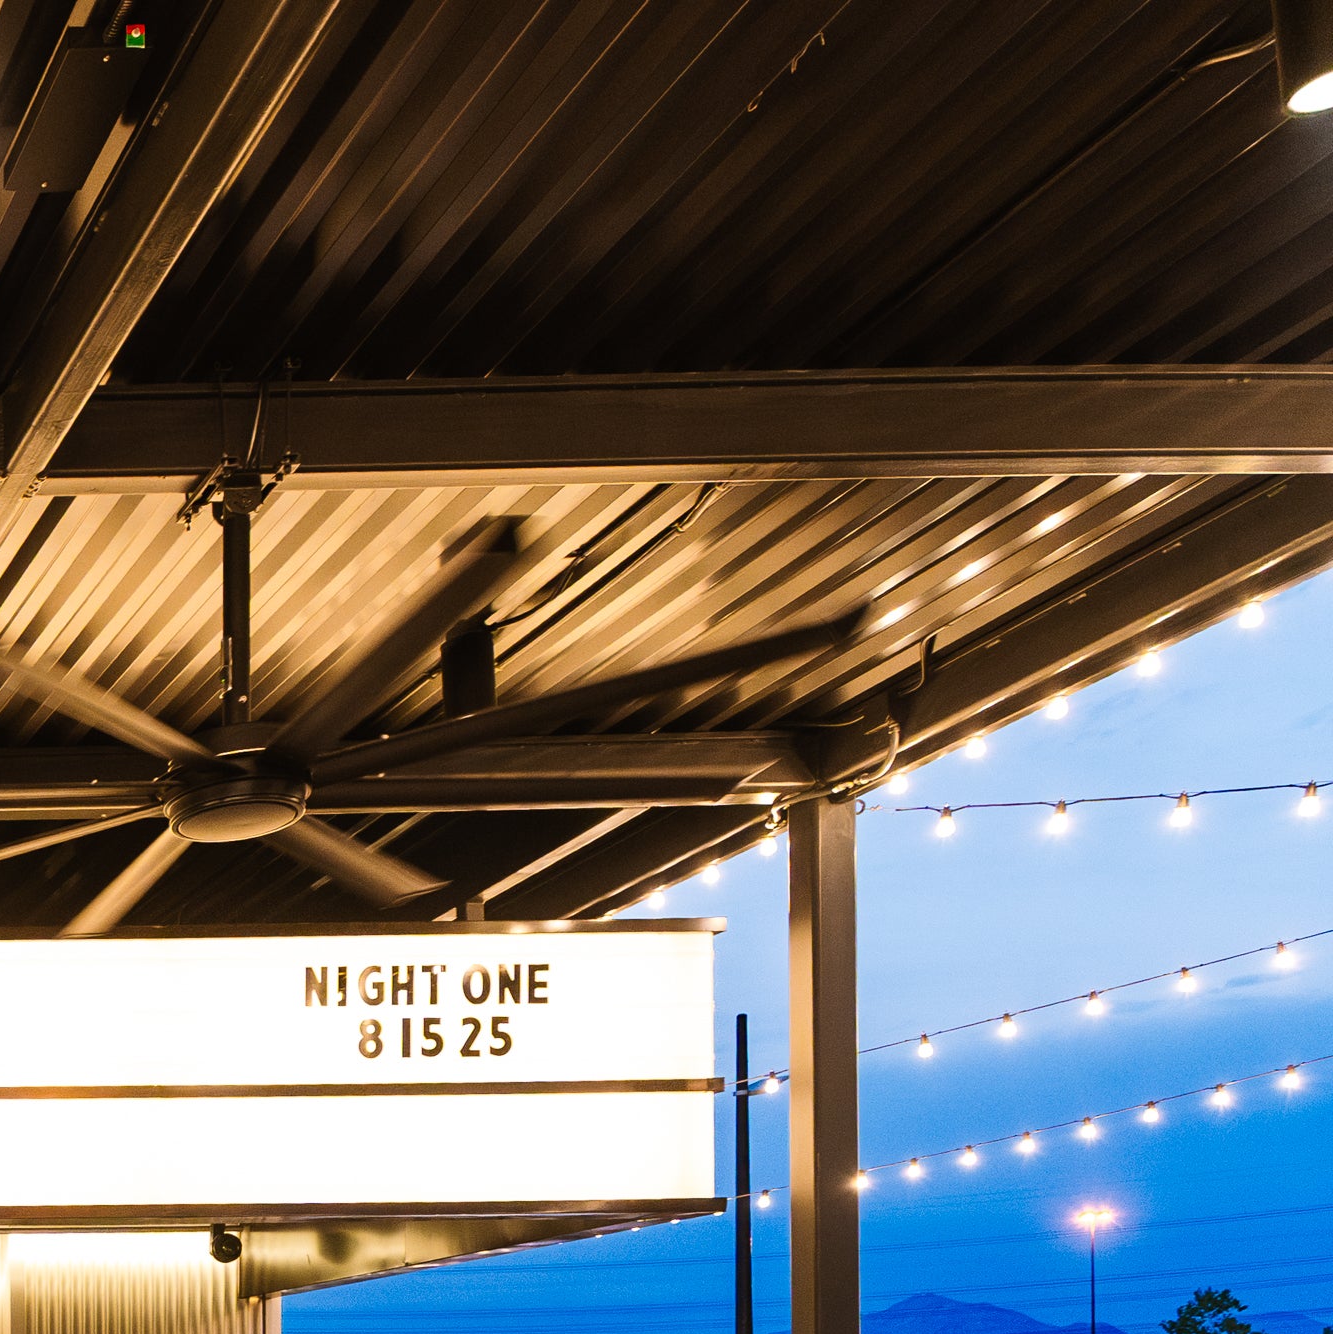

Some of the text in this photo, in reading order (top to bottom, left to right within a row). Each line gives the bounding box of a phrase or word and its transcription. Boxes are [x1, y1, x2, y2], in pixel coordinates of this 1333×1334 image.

[305, 963, 550, 1007] NIGHT ONE
[358, 1016, 512, 1059] 8 15 25
